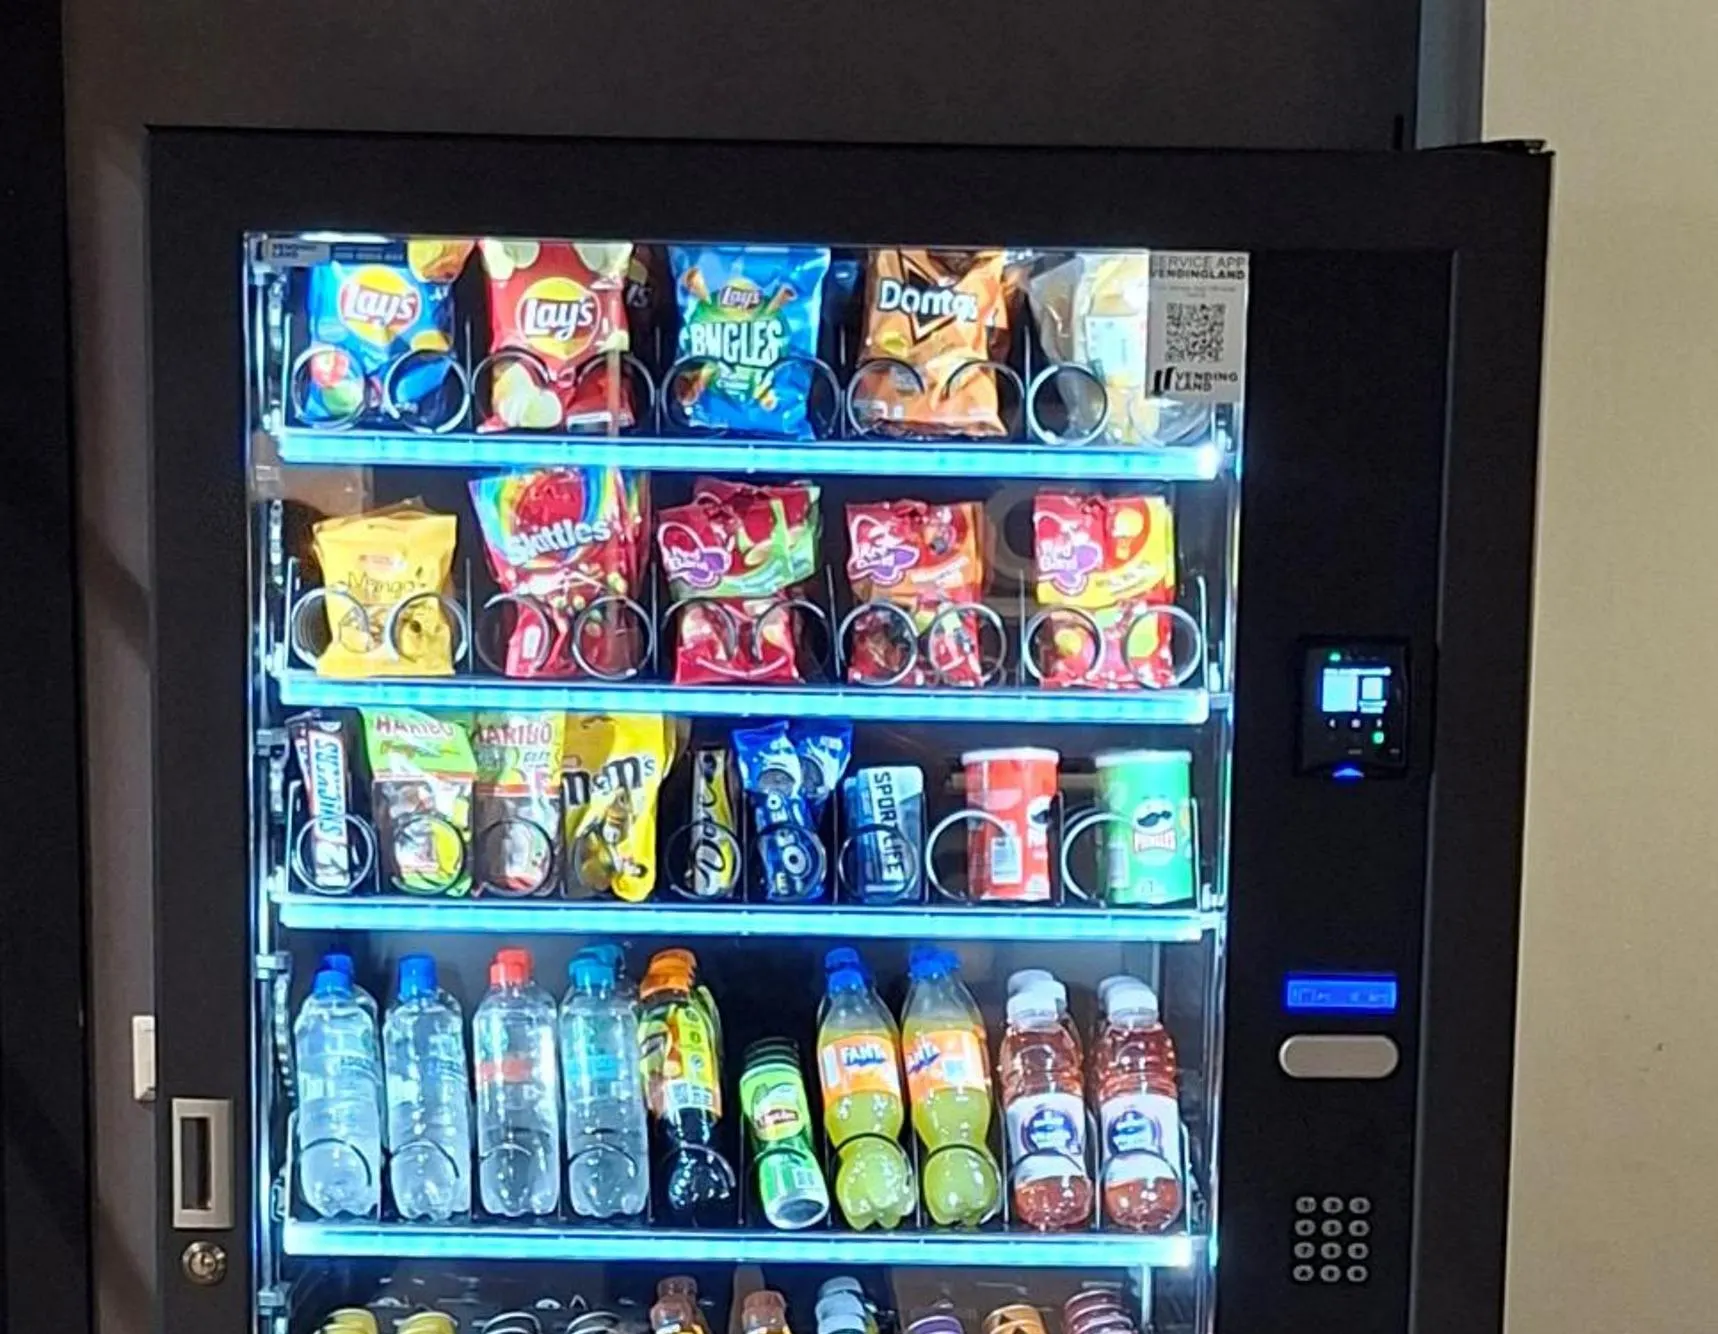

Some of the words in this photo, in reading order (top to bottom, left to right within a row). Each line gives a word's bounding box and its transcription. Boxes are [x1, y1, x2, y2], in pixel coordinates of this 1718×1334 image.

[523, 296, 595, 341] Lay's
[1175, 371, 1239, 382] VENDING
[1175, 382, 1213, 392] LAND
[507, 517, 611, 566] Skittles
[376, 714, 454, 738] HARIBO
